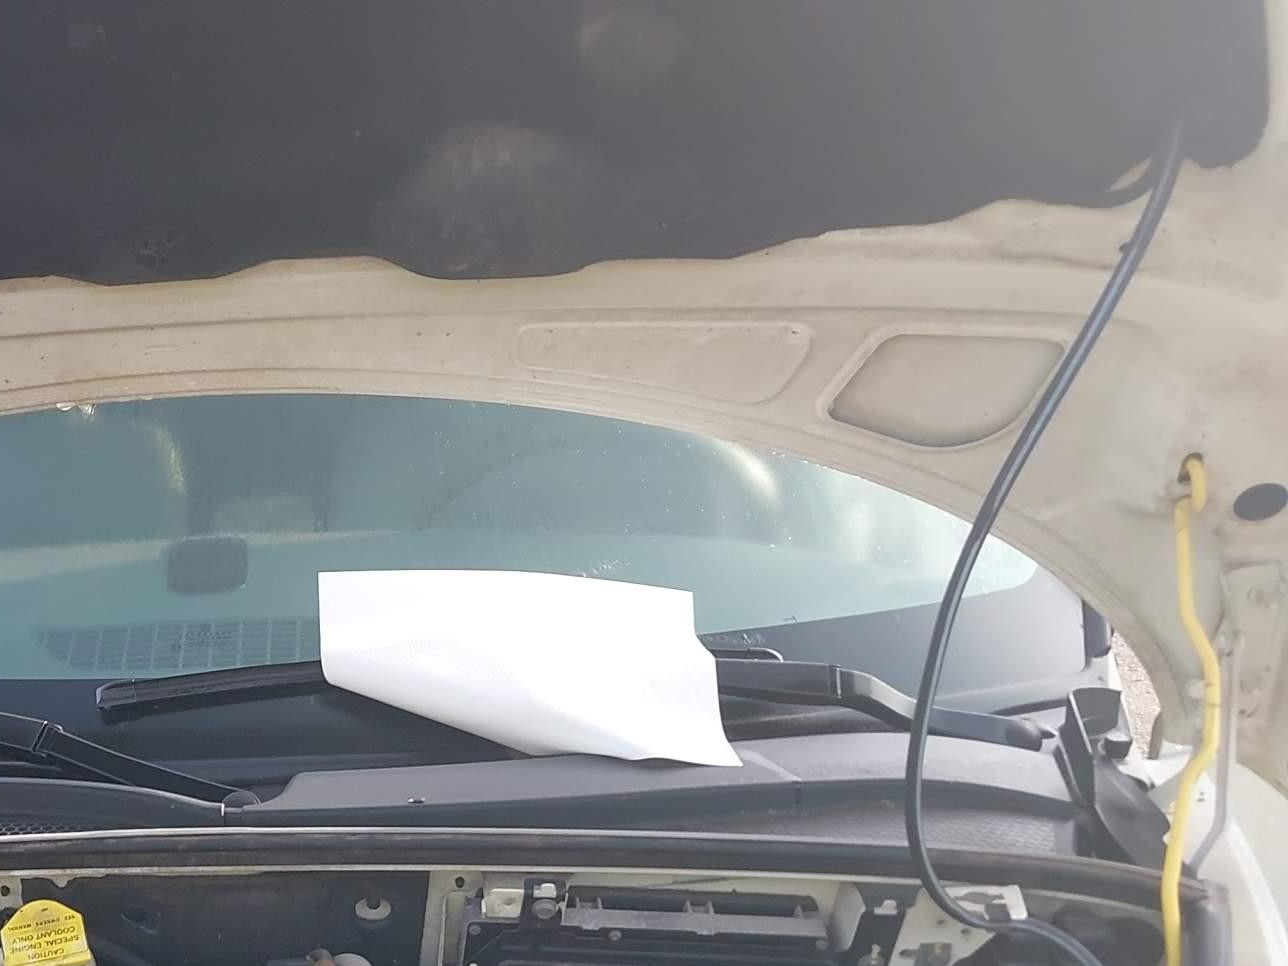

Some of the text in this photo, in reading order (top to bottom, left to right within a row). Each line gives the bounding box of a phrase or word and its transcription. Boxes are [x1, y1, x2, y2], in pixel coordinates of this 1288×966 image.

[10, 934, 80, 954] SPECIAL ENGINE
[12, 926, 76, 945] COOLANT ONLY
[28, 948, 65, 960] CAUTION
